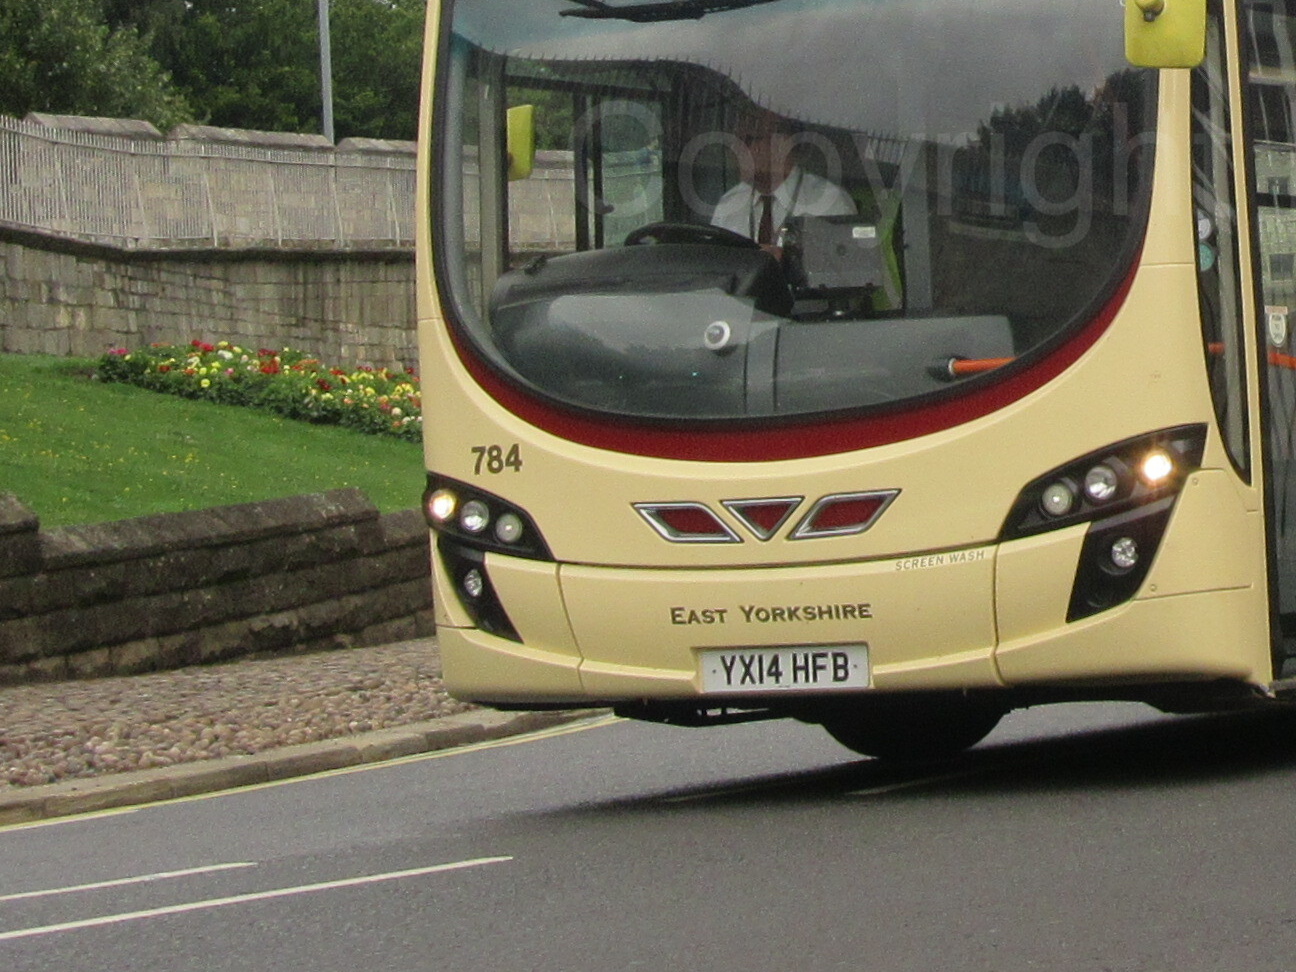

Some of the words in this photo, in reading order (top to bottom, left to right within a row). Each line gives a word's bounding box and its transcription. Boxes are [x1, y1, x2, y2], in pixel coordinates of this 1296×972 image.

[471, 443, 523, 476] 784
[895, 555, 944, 571] SCREEN
[949, 550, 985, 564] WASH
[670, 607, 728, 625] EAST
[739, 603, 873, 623] YORKSHIRE
[720, 653, 784, 685] YX14
[791, 651, 850, 684] HFB
